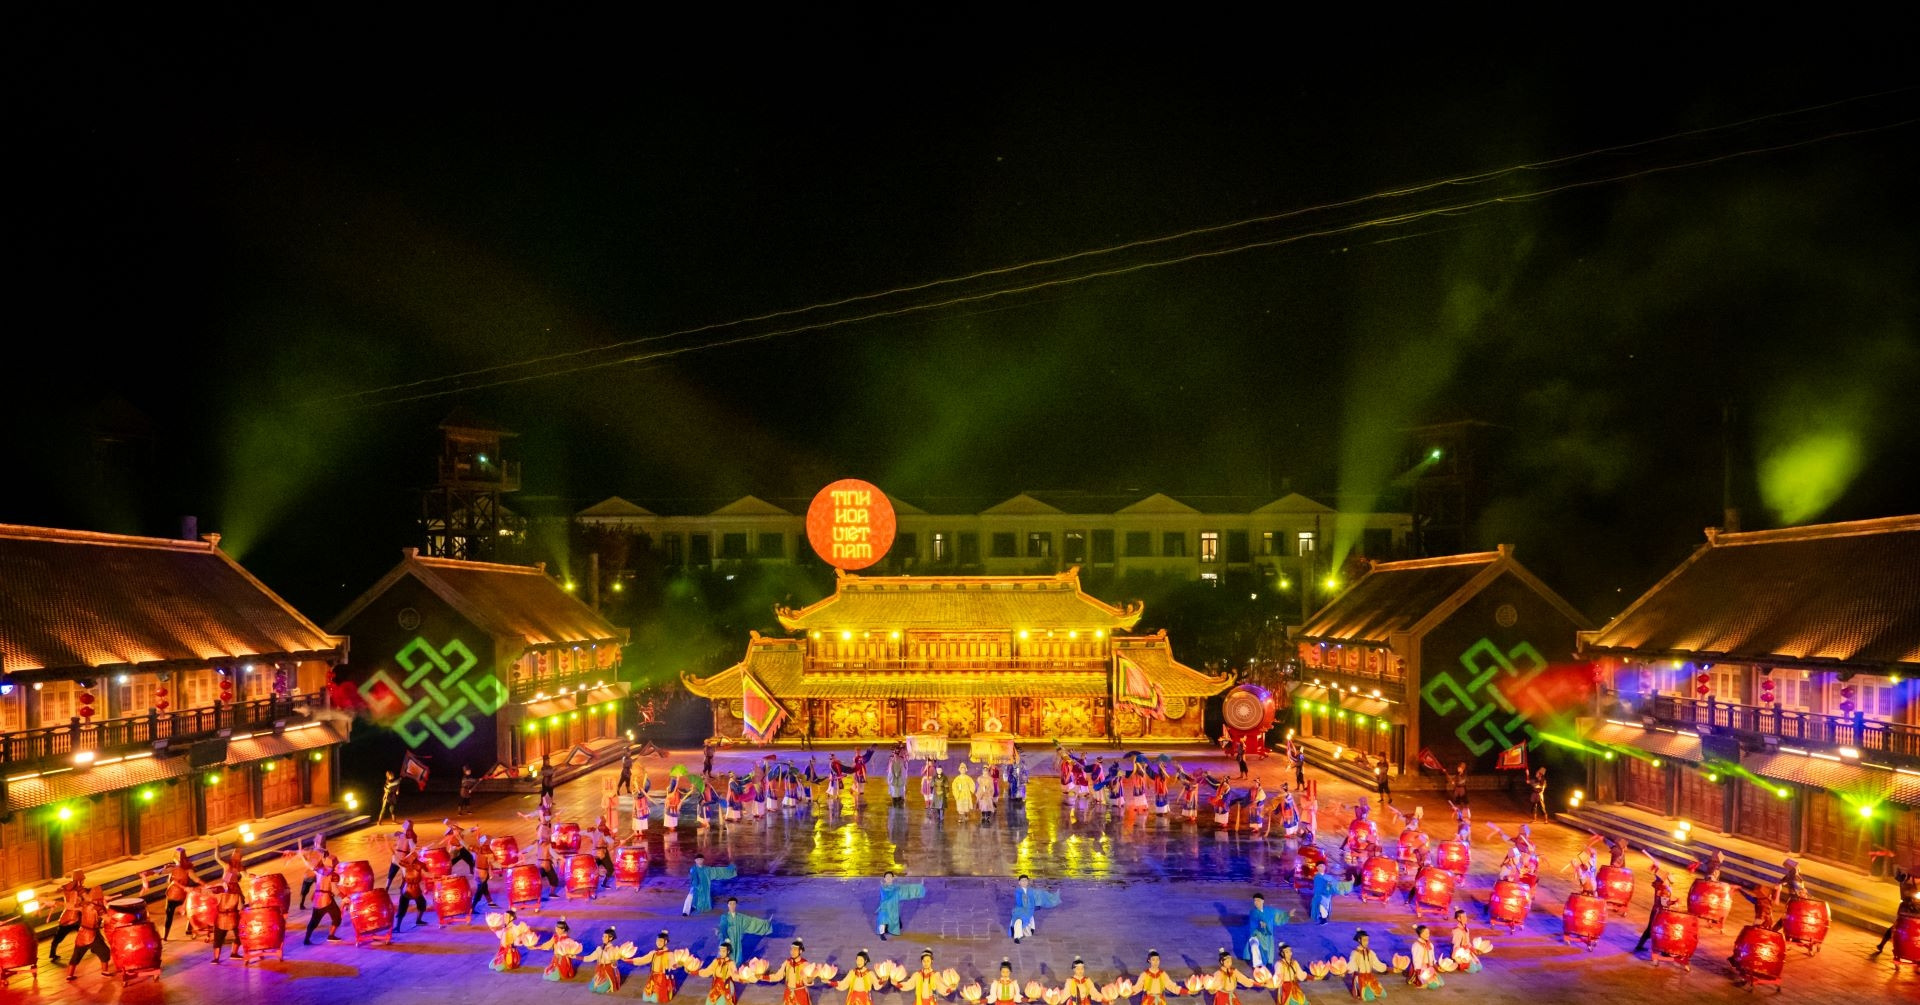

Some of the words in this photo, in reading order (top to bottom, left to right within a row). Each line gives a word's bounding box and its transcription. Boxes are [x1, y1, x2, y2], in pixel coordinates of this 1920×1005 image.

[830, 490, 871, 506] TINH
[834, 508, 869, 523] HOA
[833, 542, 871, 559] NAM
